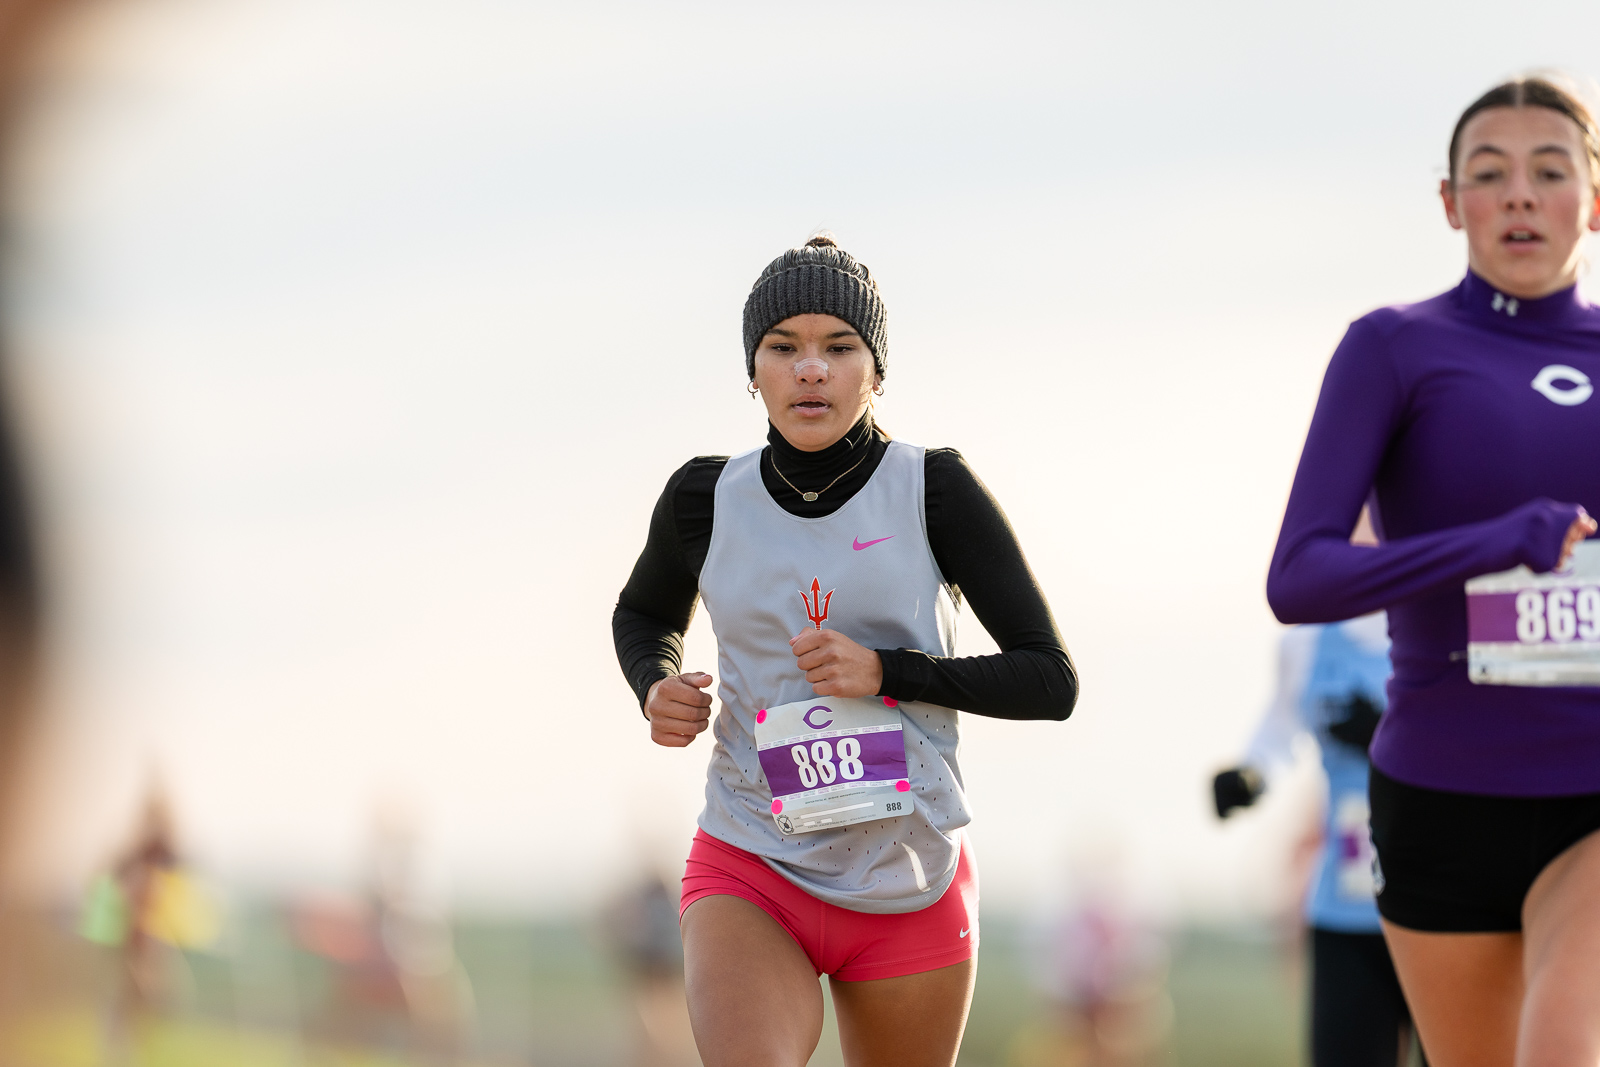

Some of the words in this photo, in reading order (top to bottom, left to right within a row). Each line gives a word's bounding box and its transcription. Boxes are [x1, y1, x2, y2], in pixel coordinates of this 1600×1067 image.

[1531, 364, 1594, 406] C
[1515, 587, 1600, 644] 869
[803, 705, 834, 730] C
[790, 737, 865, 789] 888
[886, 802, 902, 811] 888
